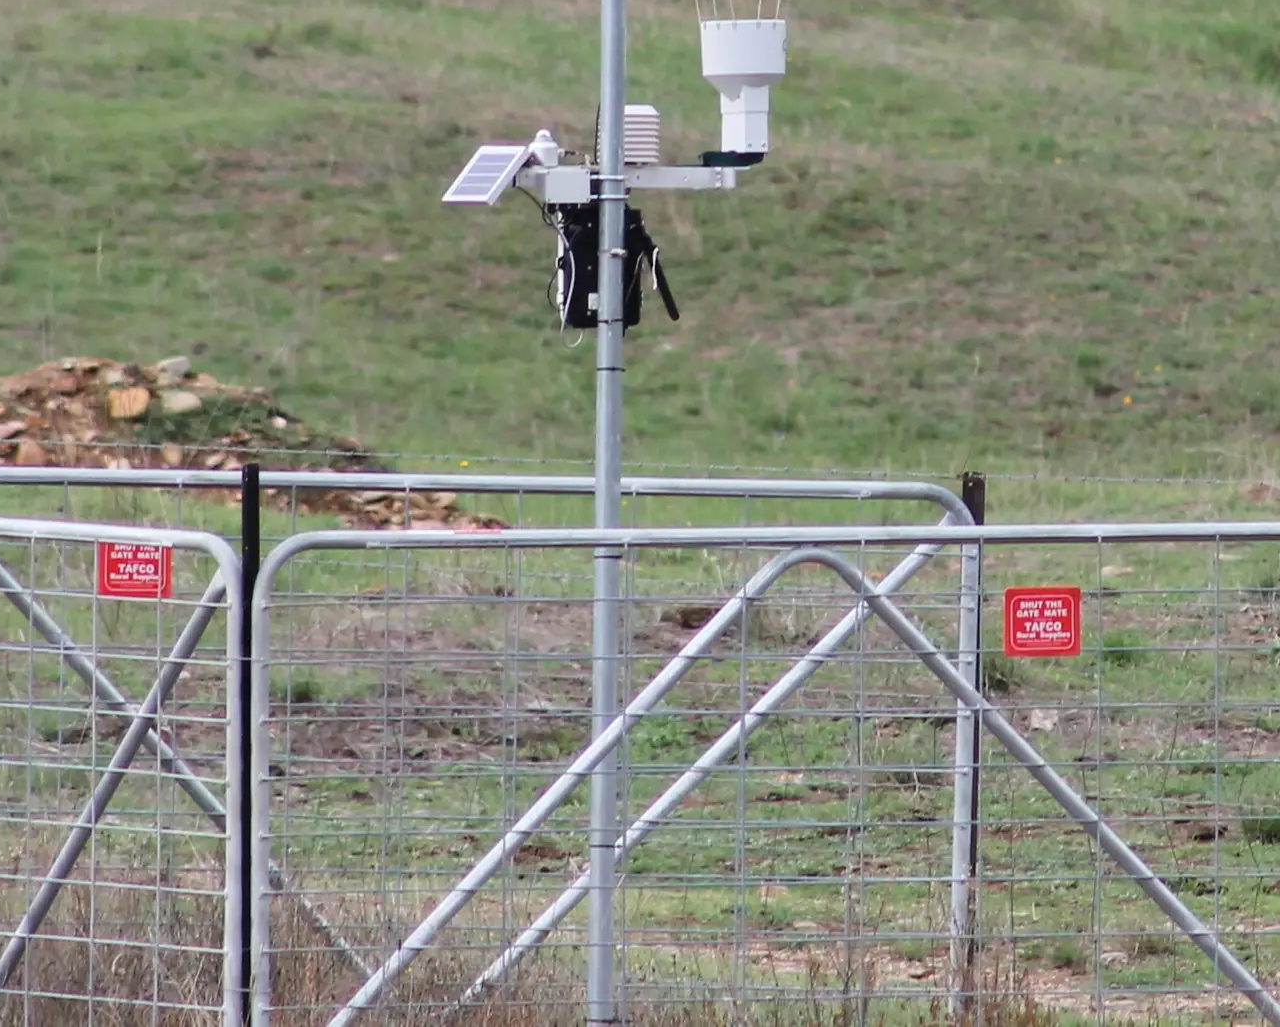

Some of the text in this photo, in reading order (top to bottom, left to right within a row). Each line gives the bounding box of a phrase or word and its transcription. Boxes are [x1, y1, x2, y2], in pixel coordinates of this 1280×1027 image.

[110, 551, 133, 559] GATE
[117, 563, 155, 574] TAFCO
[1020, 600, 1062, 609] SHUT THE
[1016, 608, 1068, 618] GATE MATE
[1024, 621, 1062, 632] TAFCO
[1016, 631, 1071, 641] Rural Supplies
